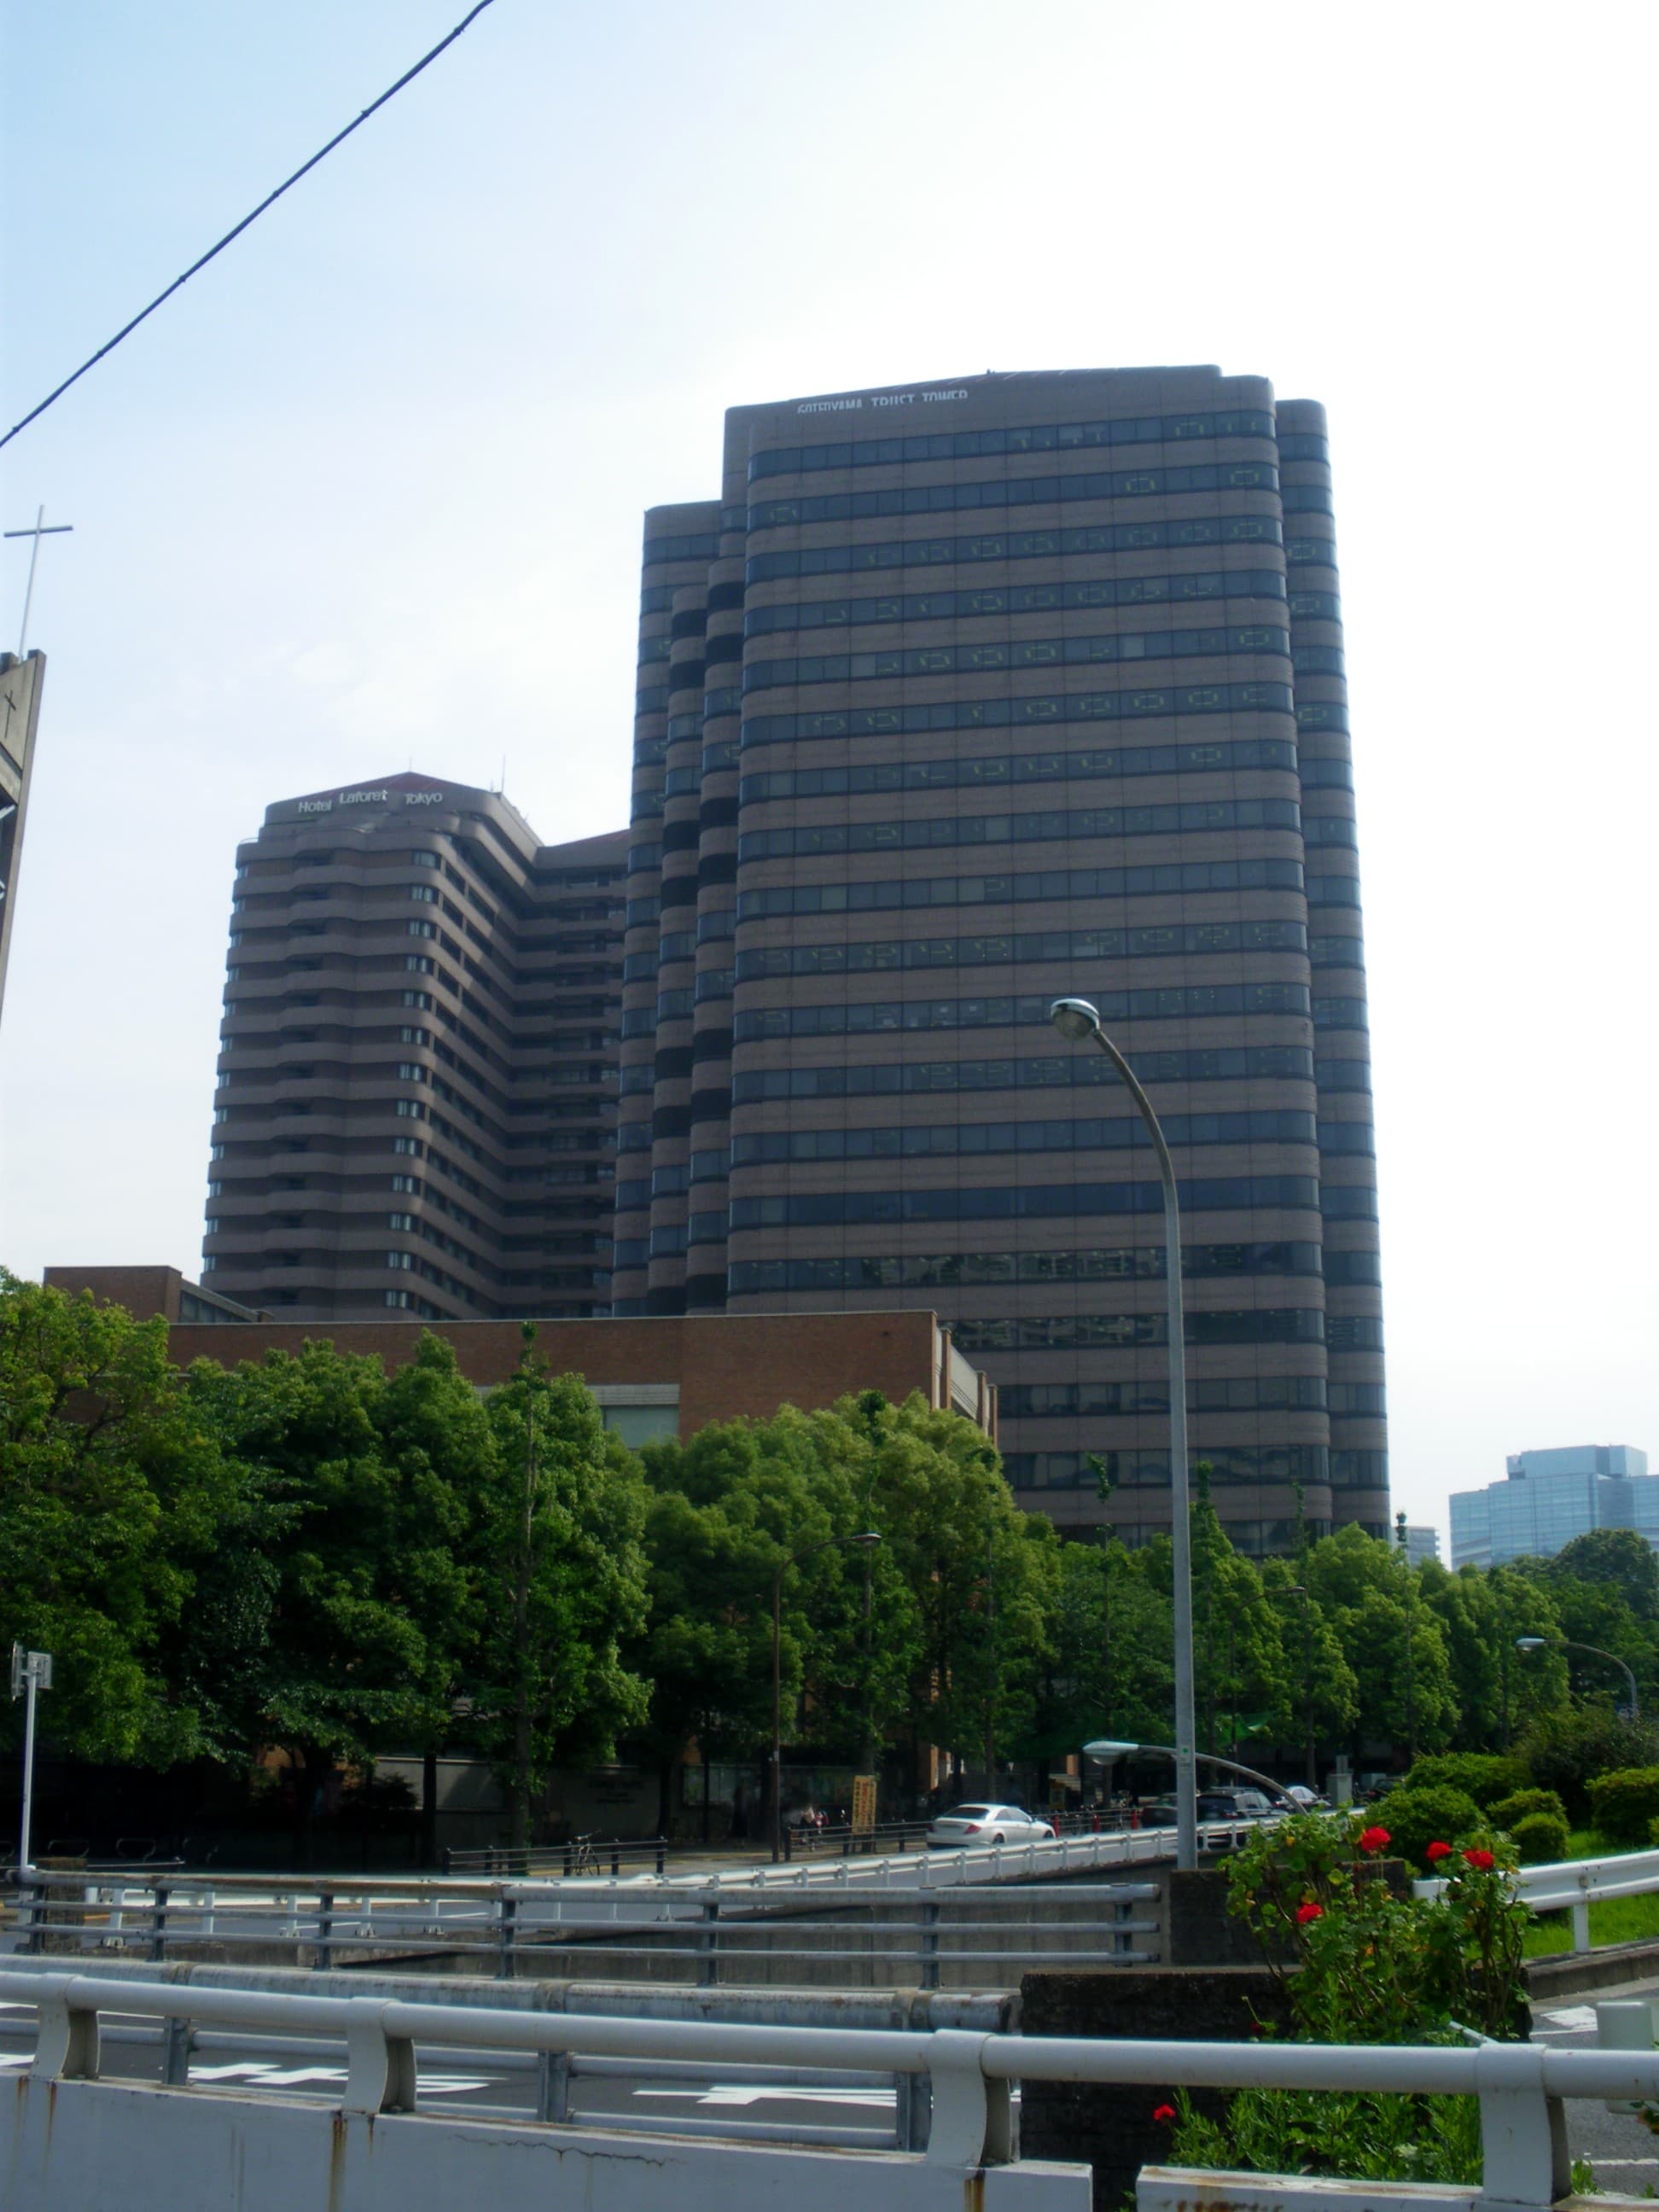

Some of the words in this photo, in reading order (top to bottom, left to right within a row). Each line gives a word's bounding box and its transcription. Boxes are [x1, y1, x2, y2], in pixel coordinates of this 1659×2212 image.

[298, 800, 332, 813] Hotel
[339, 789, 388, 804] Laforet
[405, 792, 442, 806] Tokyo
